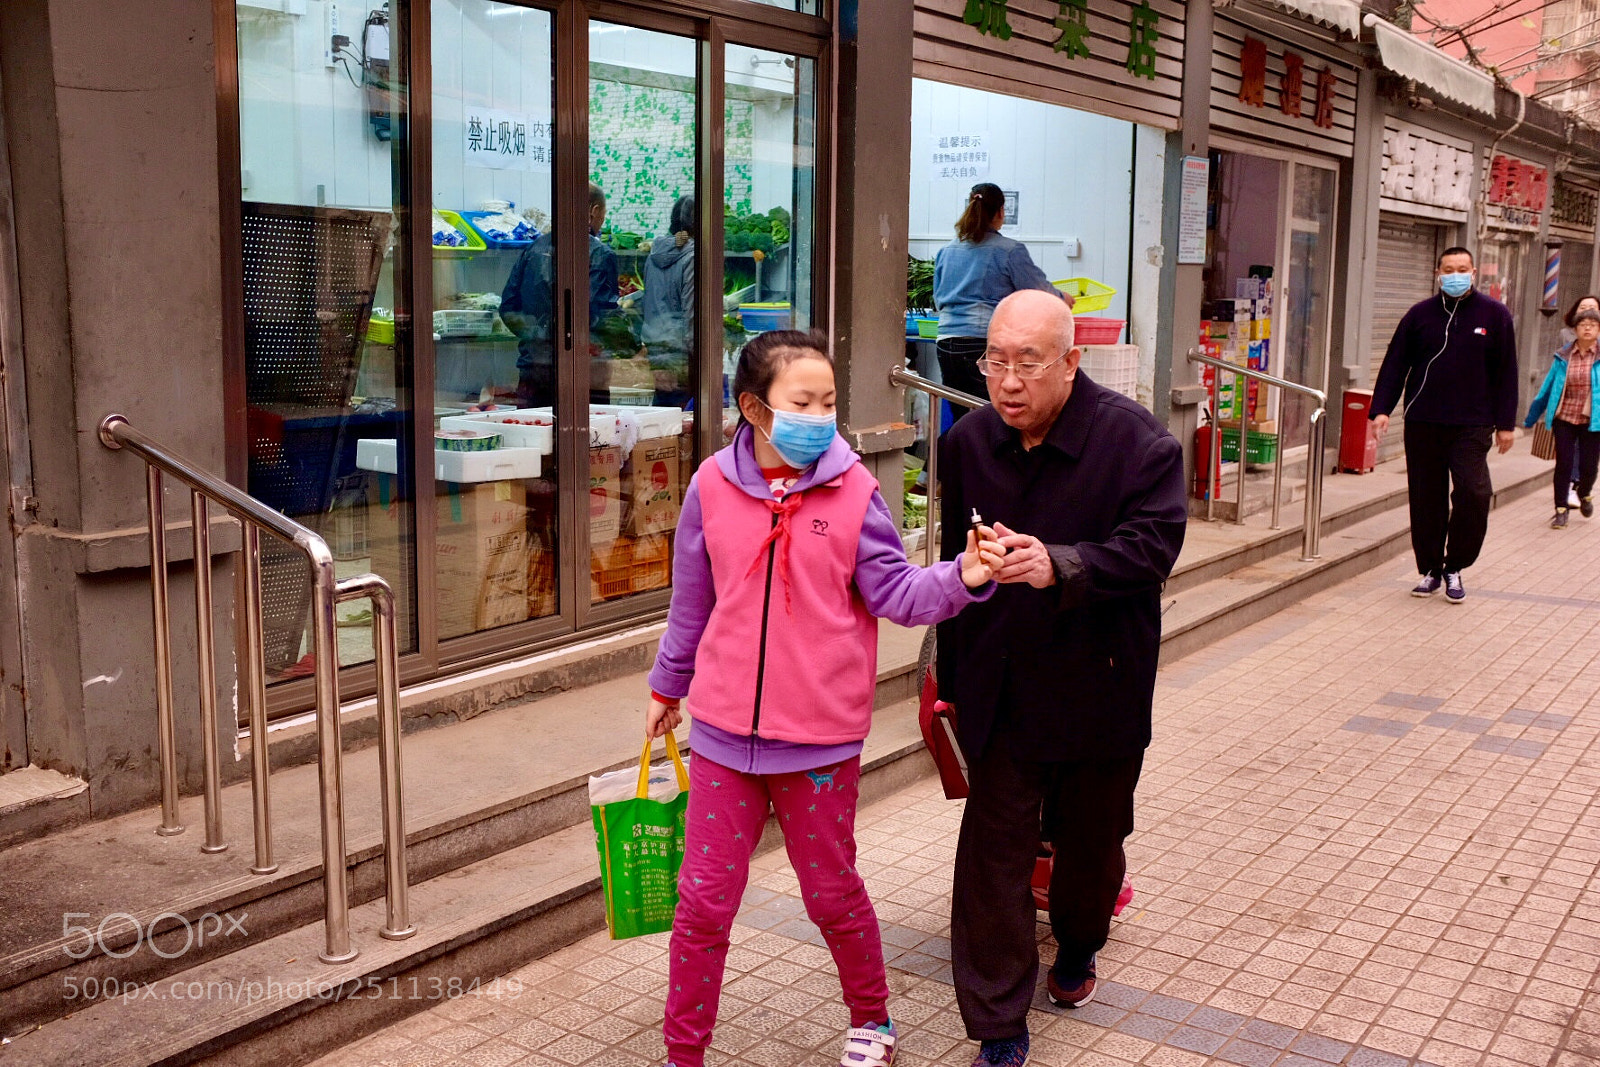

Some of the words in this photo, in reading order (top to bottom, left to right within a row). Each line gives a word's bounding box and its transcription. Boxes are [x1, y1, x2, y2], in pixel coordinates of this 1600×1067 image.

[468, 116, 526, 156] 禁止吸烟
[939, 135, 981, 148] 温馨提示
[940, 166, 977, 178] 丢失自负
[853, 1030, 882, 1040] FASHION
